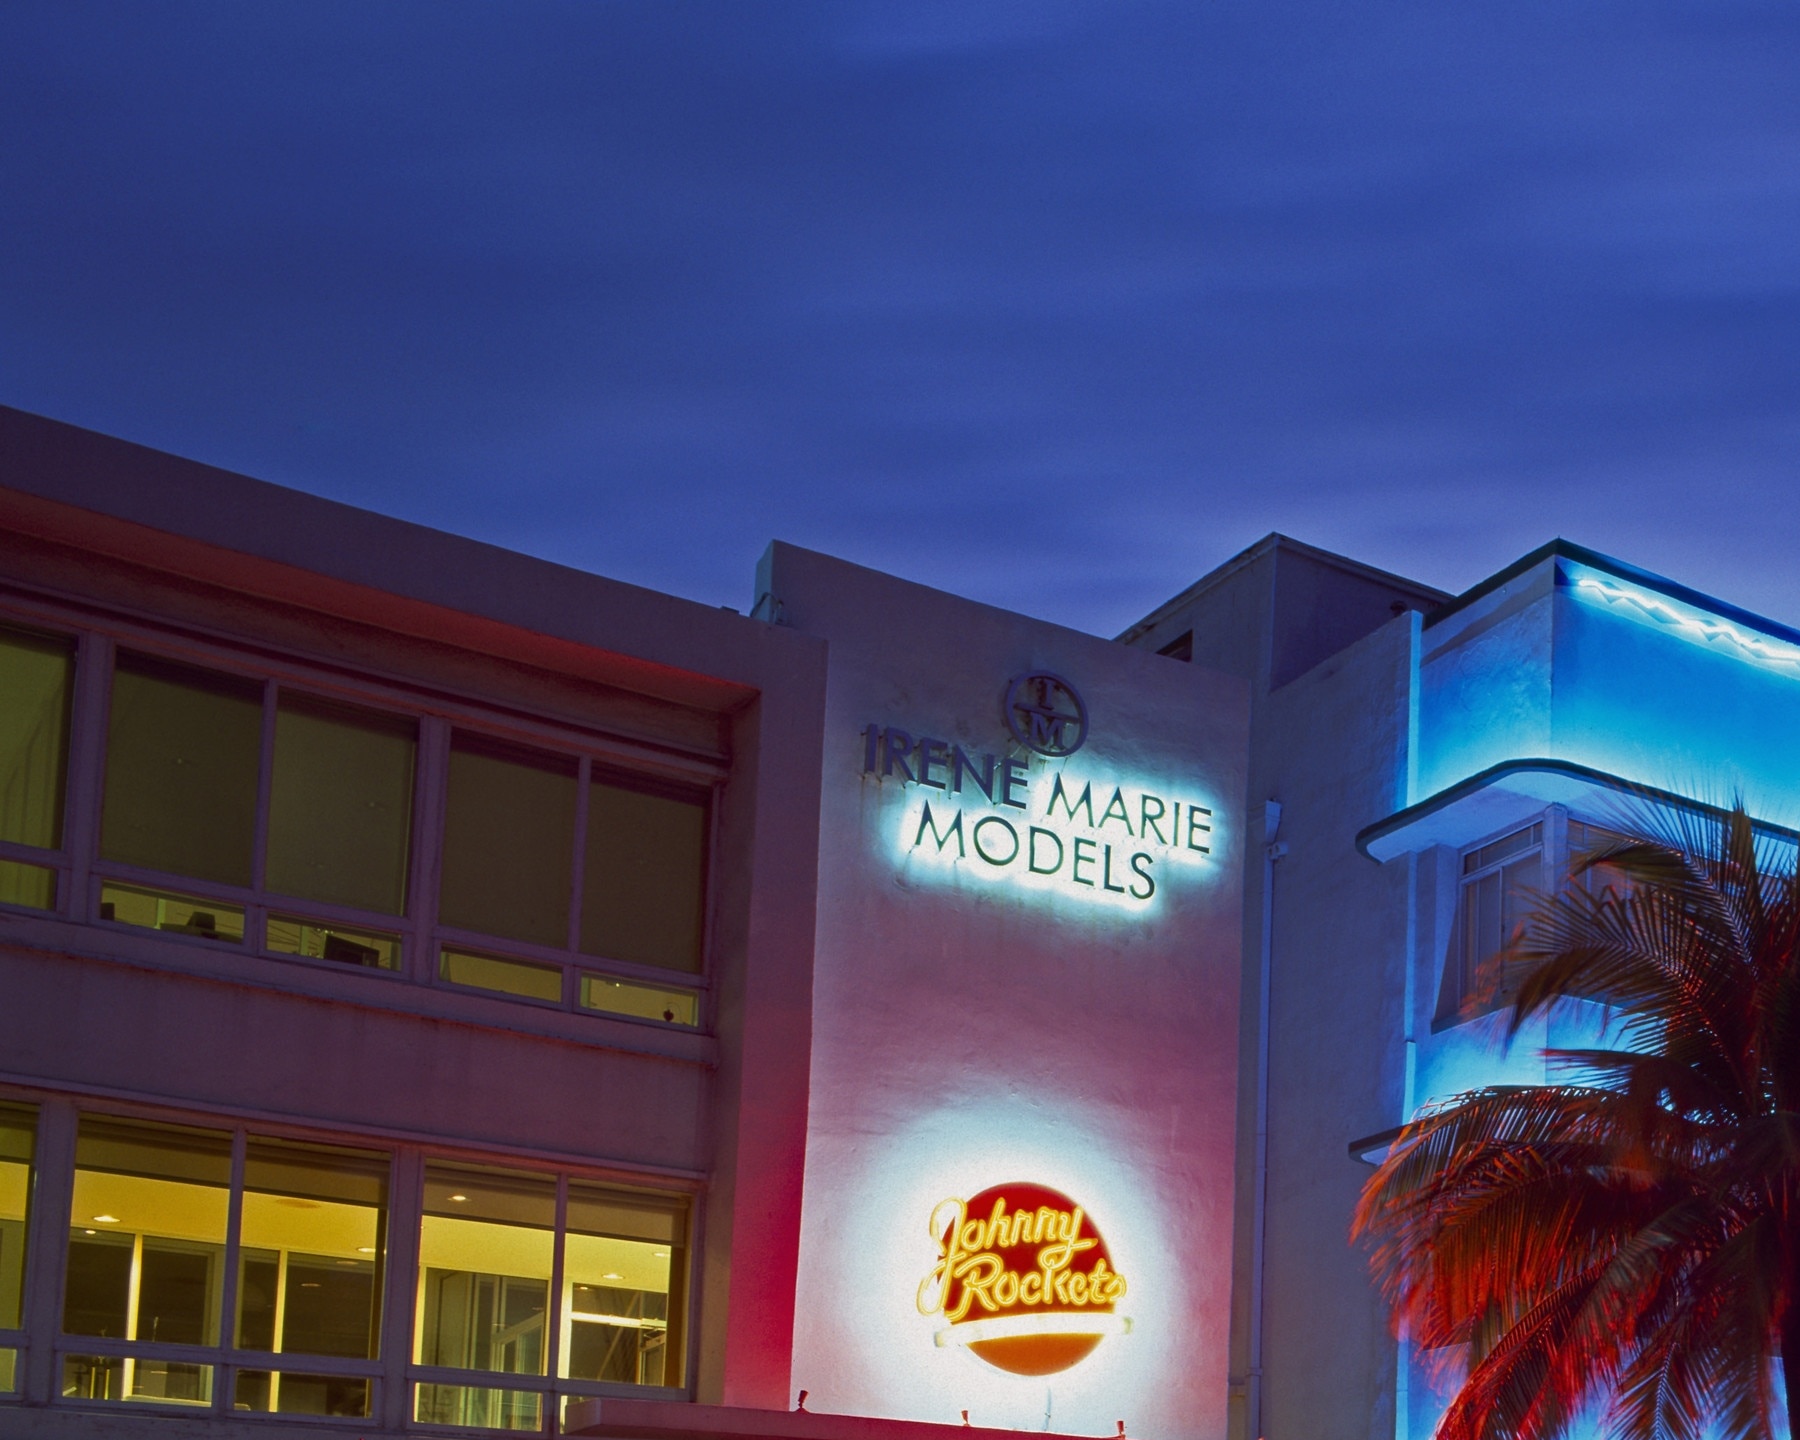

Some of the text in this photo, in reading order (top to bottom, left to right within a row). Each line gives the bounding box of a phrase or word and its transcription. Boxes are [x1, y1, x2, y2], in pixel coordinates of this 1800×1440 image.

[863, 723, 1213, 854] IRENE MARIE
[915, 799, 1156, 900] MODELS
[917, 1197, 1098, 1316] Johnny
[944, 1254, 1127, 1321] Rockets
